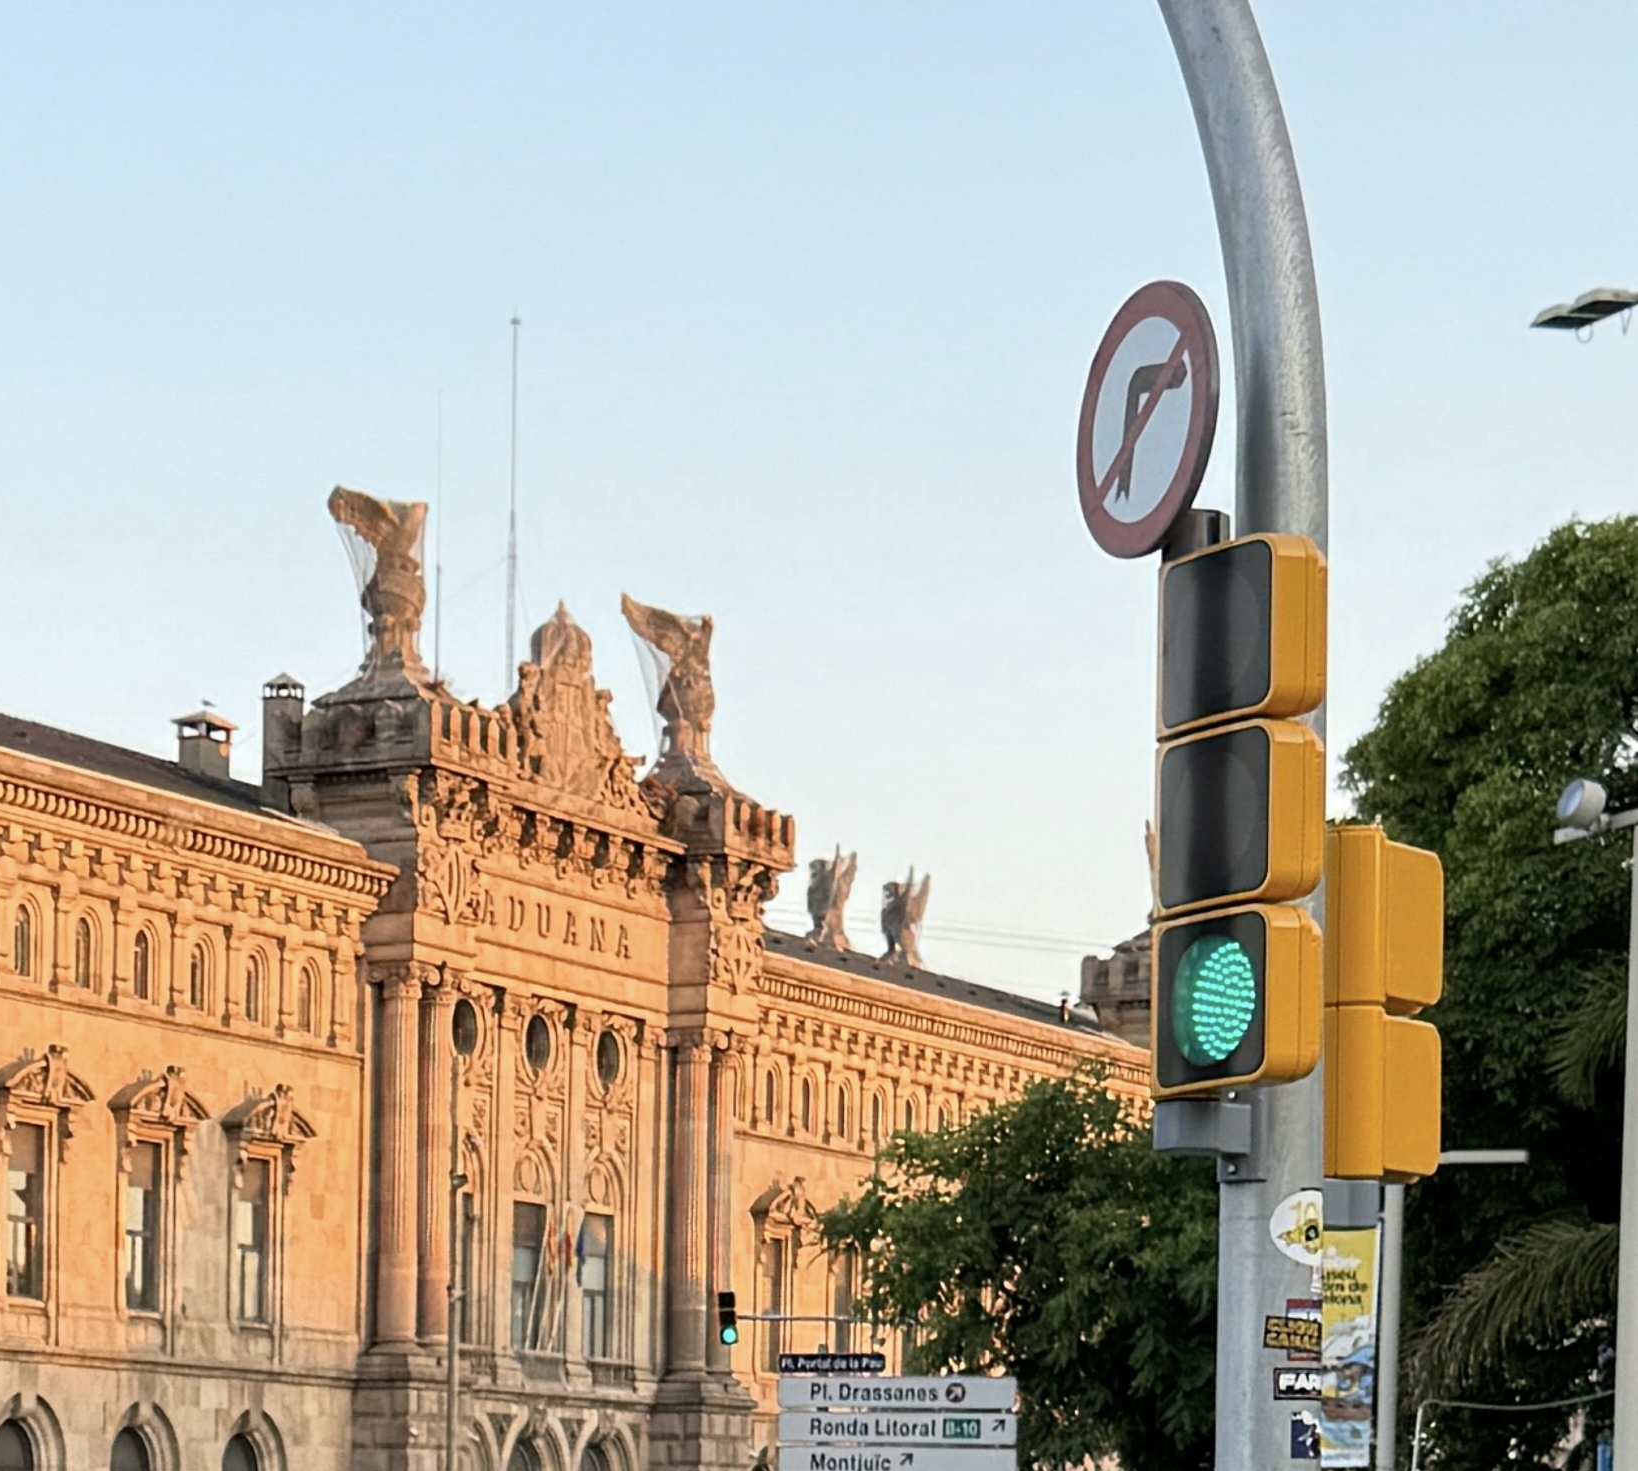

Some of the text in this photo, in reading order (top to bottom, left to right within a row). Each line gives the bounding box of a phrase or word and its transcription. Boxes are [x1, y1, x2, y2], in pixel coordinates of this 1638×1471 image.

[481, 889, 632, 960] ADUANA
[809, 1383, 939, 1401] Pl. Drassanes
[809, 1418, 978, 1437] Ronda Litoral B-10
